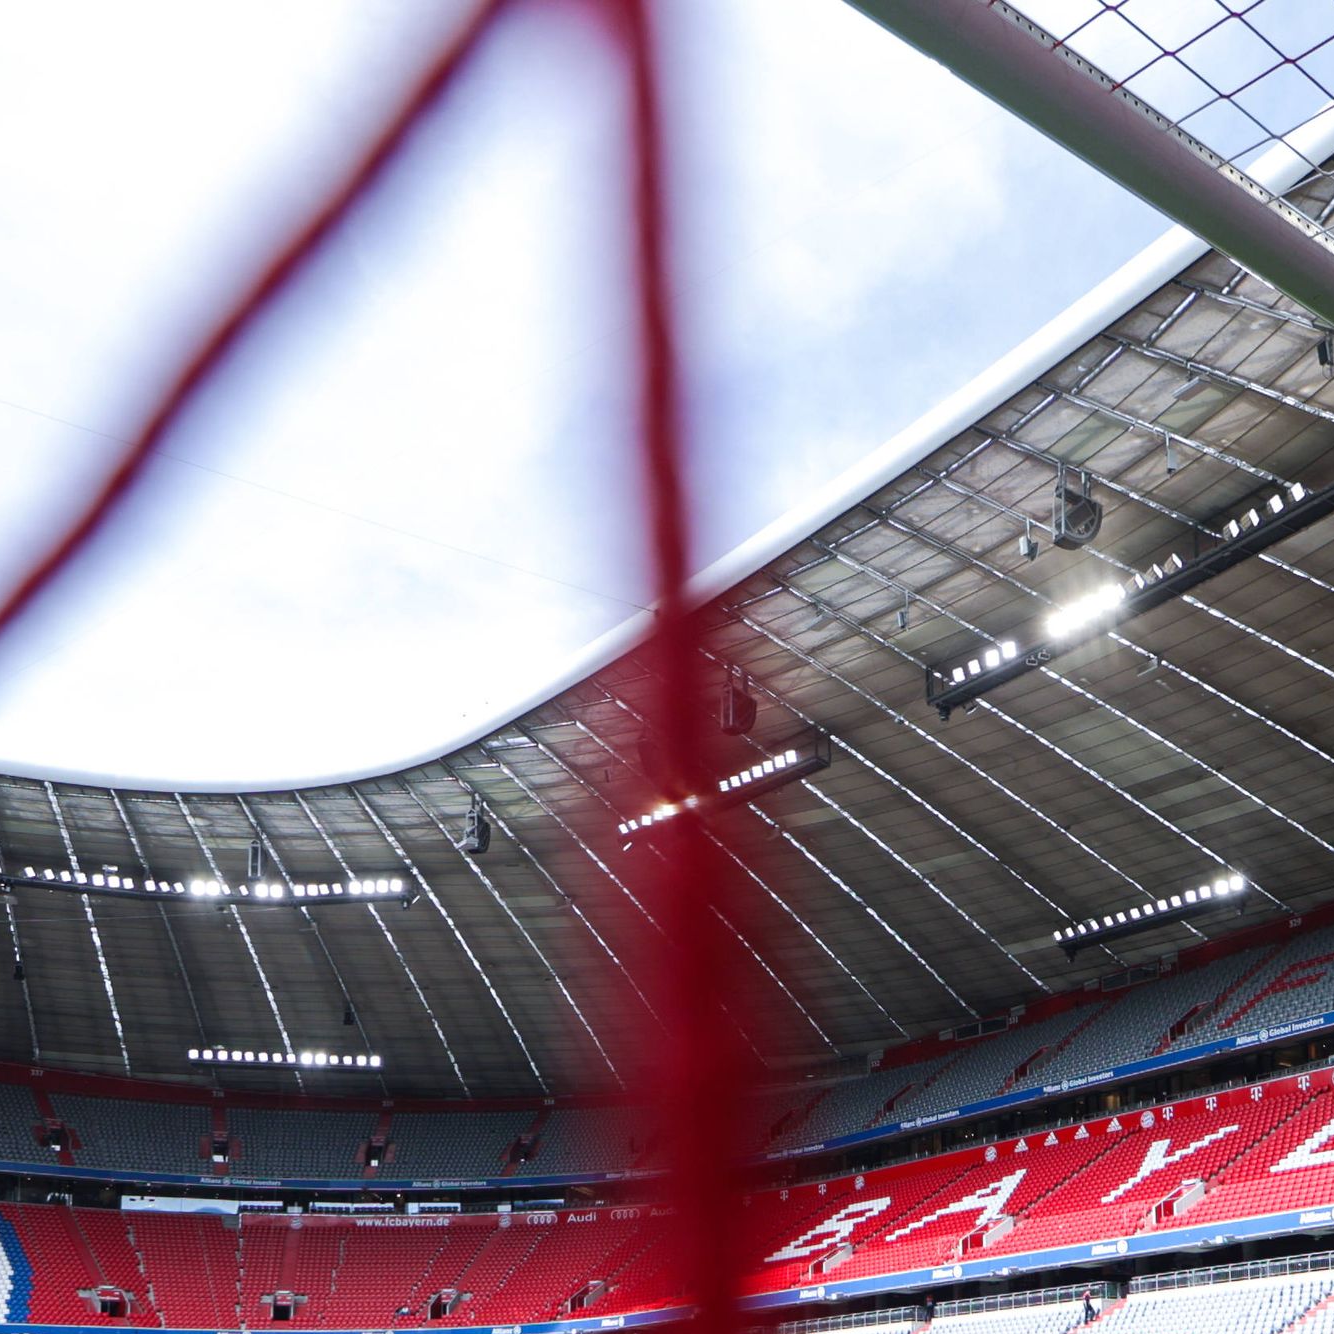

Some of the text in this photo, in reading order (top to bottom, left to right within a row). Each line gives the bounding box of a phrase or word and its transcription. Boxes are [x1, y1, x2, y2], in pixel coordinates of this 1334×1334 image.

[1236, 1017, 1324, 1046] Allianz Global Investors
[356, 1216, 450, 1229] www.fcbayern.de
[567, 1212, 597, 1224] Audi
[1299, 1209, 1328, 1224] Allianz
[1091, 1243, 1118, 1255] Allianz
